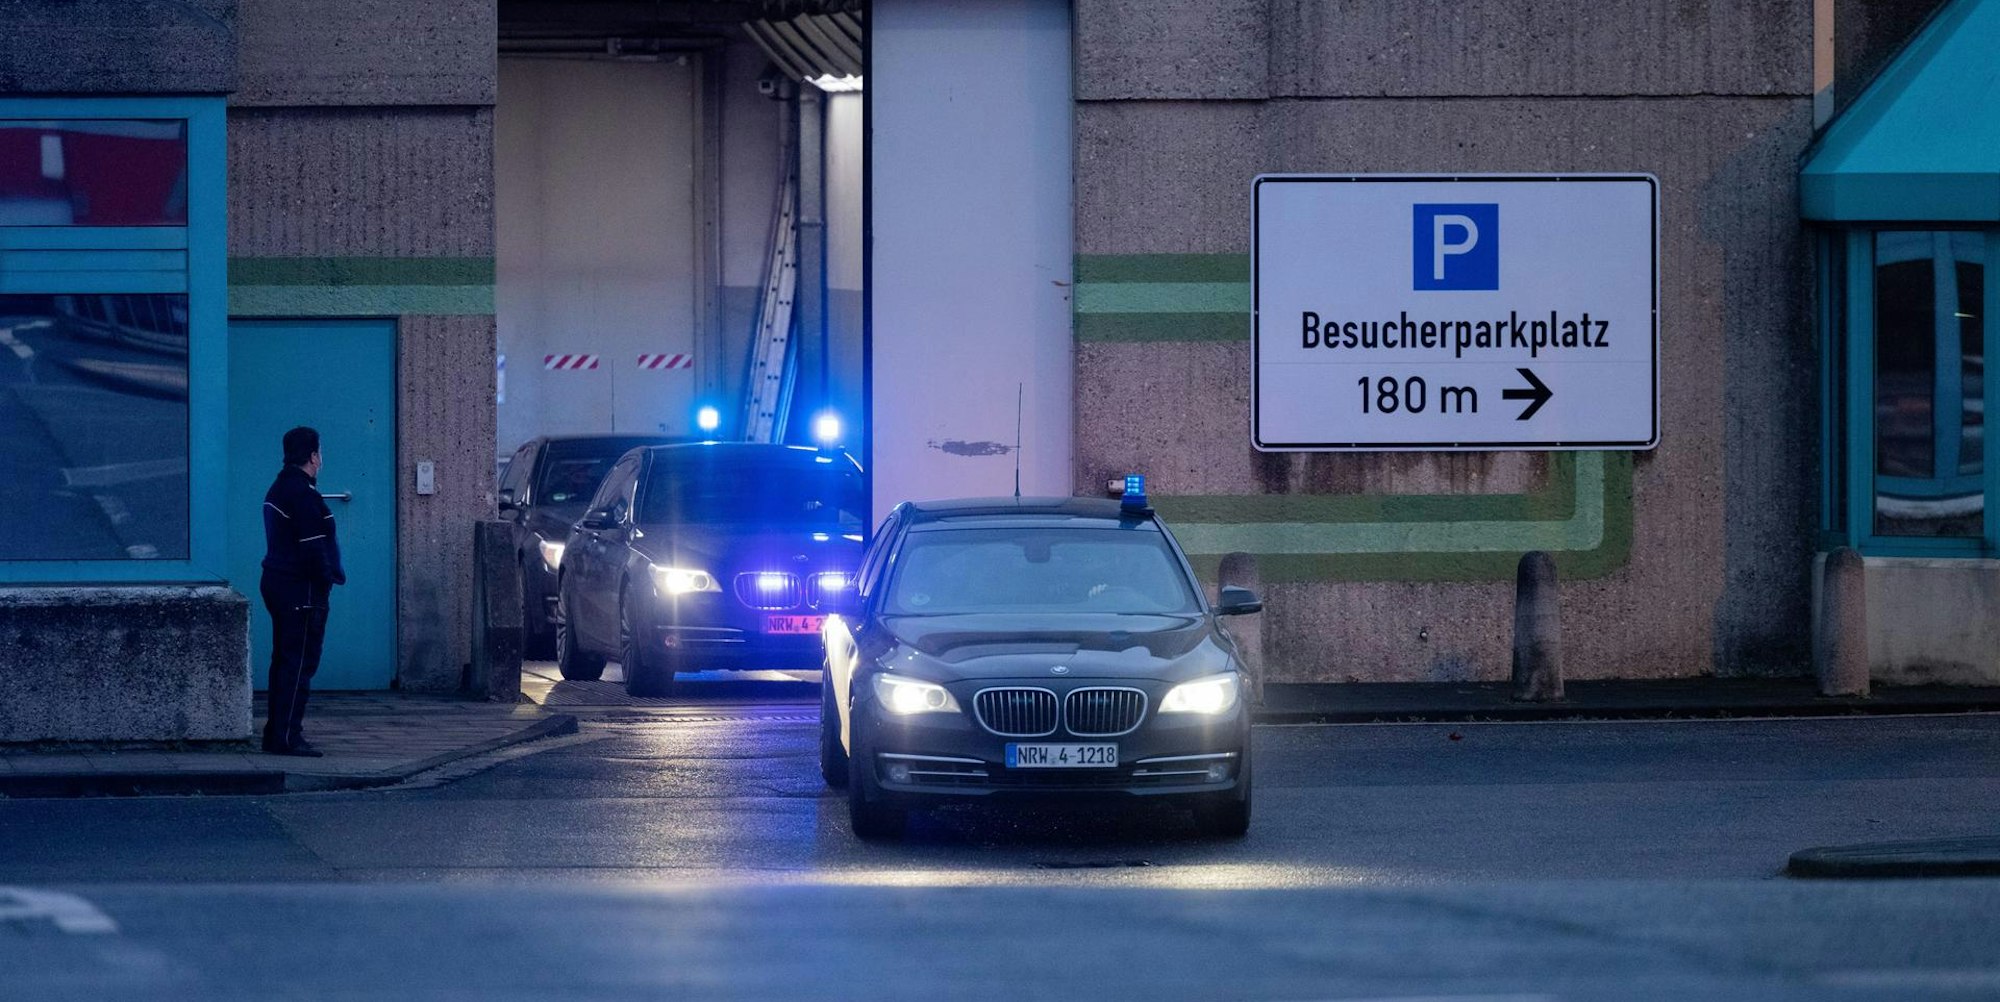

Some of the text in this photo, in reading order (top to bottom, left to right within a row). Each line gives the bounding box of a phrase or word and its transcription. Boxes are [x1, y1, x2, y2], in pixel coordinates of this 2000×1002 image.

[1433, 214, 1479, 280] P
[1302, 311, 1609, 358] Besucherparkplatz
[1358, 376, 1478, 413] 180 m
[1018, 747, 1048, 764] NRW
